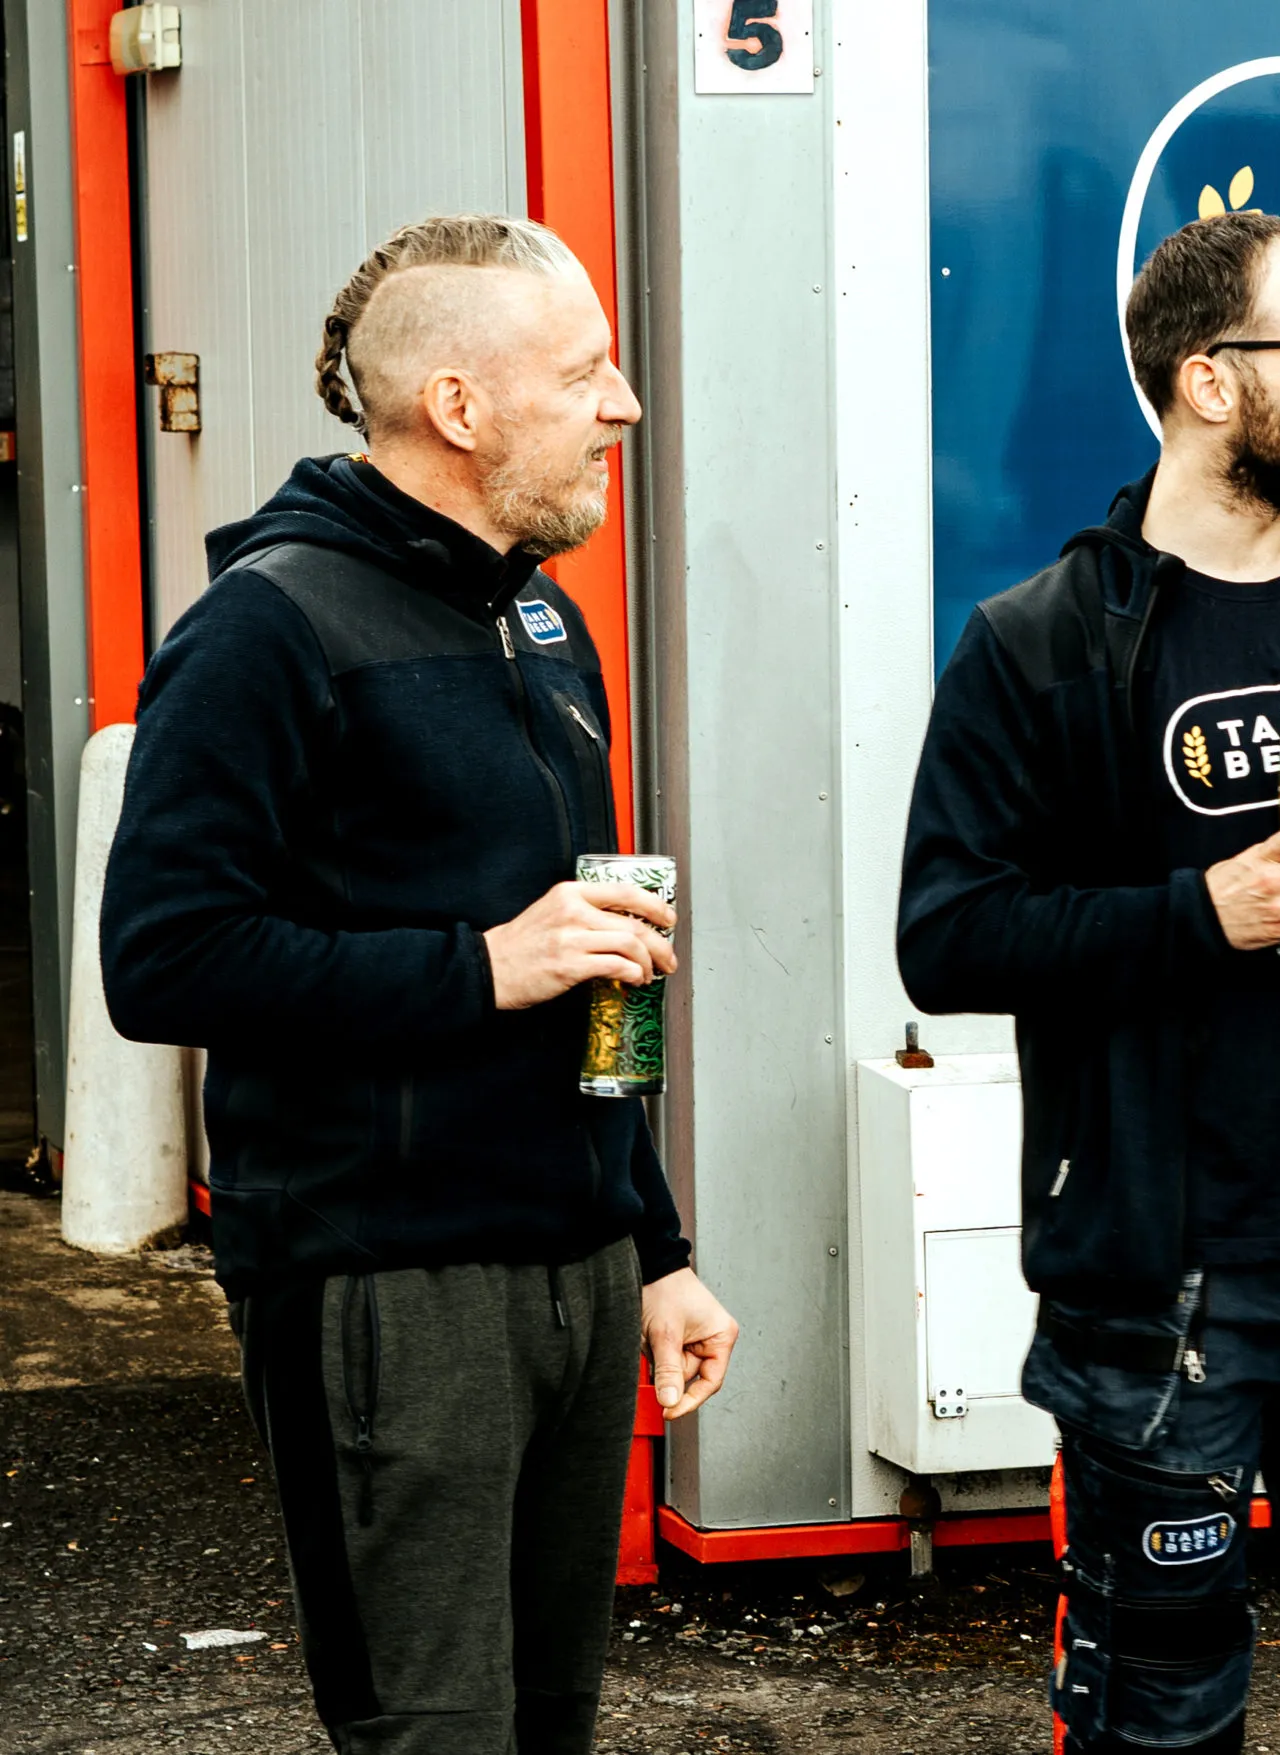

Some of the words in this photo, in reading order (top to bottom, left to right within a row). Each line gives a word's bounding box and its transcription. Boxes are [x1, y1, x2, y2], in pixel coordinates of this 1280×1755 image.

[726, 0, 783, 70] 5
[1165, 1526, 1217, 1542] TANK
[1165, 1536, 1218, 1553] BEER
